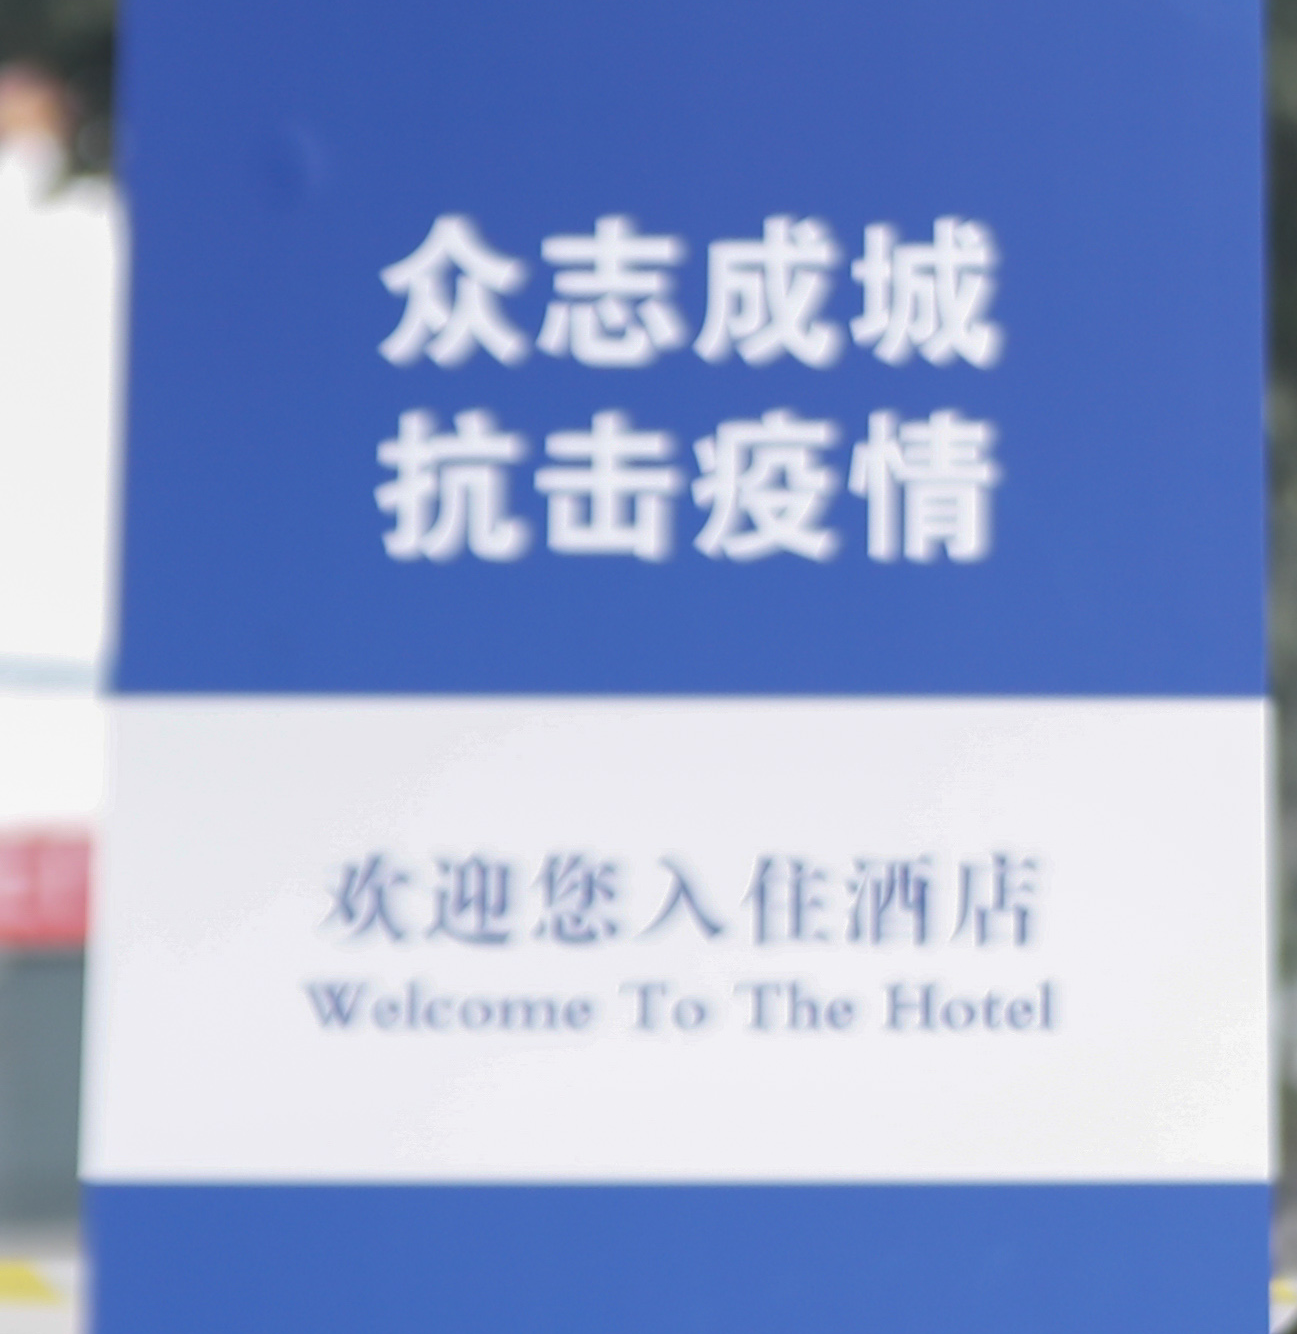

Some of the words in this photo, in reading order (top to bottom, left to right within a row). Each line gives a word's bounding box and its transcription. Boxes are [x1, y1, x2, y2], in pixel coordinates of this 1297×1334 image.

[378, 215, 1000, 367] 众志成城
[375, 409, 1000, 564] 抗击疫情
[322, 853, 1044, 947] 欢迎您入住酒店
[305, 979, 595, 1033] Welcome
[618, 979, 708, 1033] To
[733, 979, 856, 1033] The
[882, 979, 1058, 1033] Hotel
